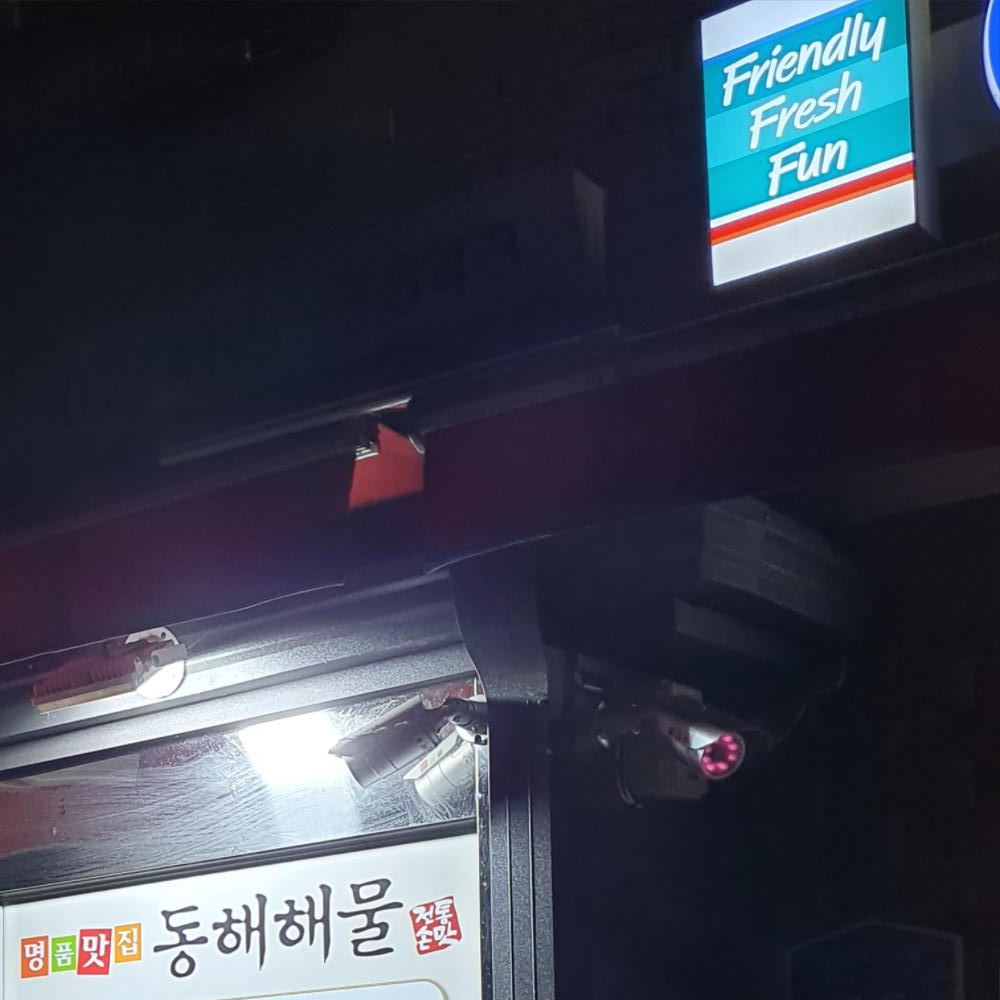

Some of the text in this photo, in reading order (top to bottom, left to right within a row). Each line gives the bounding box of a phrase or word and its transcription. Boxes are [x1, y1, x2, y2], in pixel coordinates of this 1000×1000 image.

[722, 12, 887, 107] Friendly
[750, 70, 862, 150] Fresh
[768, 139, 848, 197] Fun
[22, 878, 403, 979] 명품맛집 동해해물
